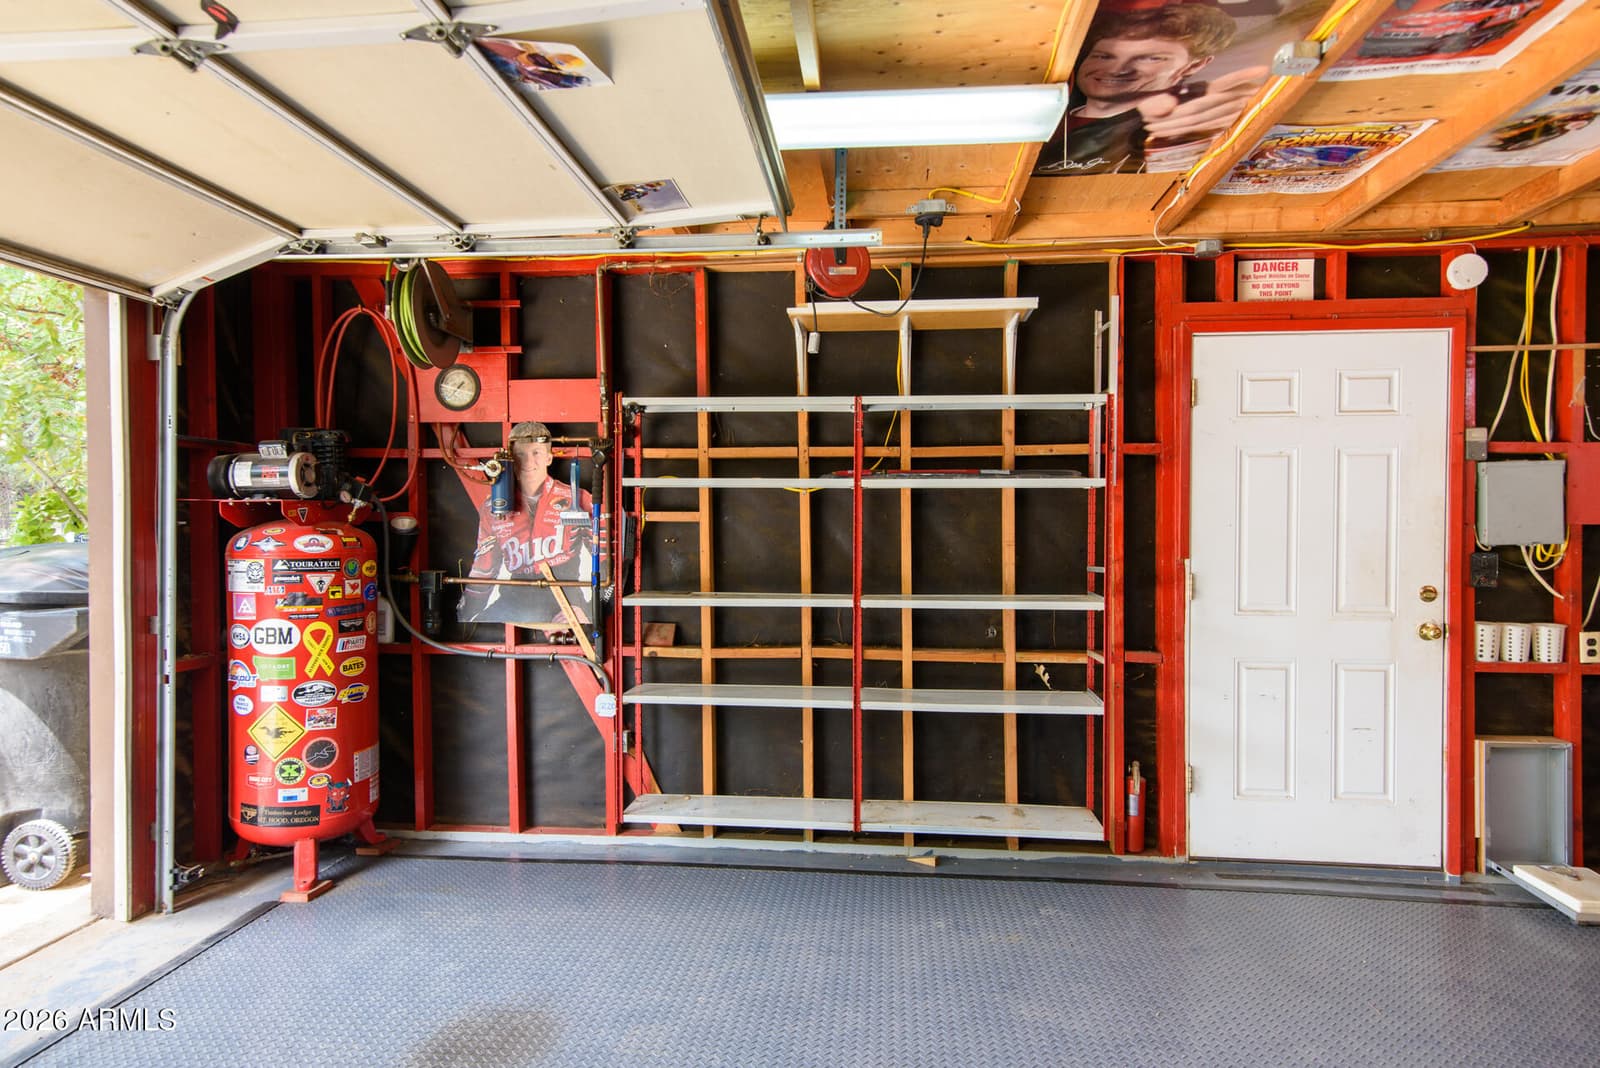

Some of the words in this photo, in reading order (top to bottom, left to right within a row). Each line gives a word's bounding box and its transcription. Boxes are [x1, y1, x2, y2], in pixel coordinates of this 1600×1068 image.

[1253, 262, 1299, 272] DANGER
[503, 525, 566, 572] Bud
[289, 560, 341, 569] TOURATECH
[254, 627, 293, 644] GBM
[342, 660, 365, 672] BATES
[291, 815, 320, 823] OREGON
